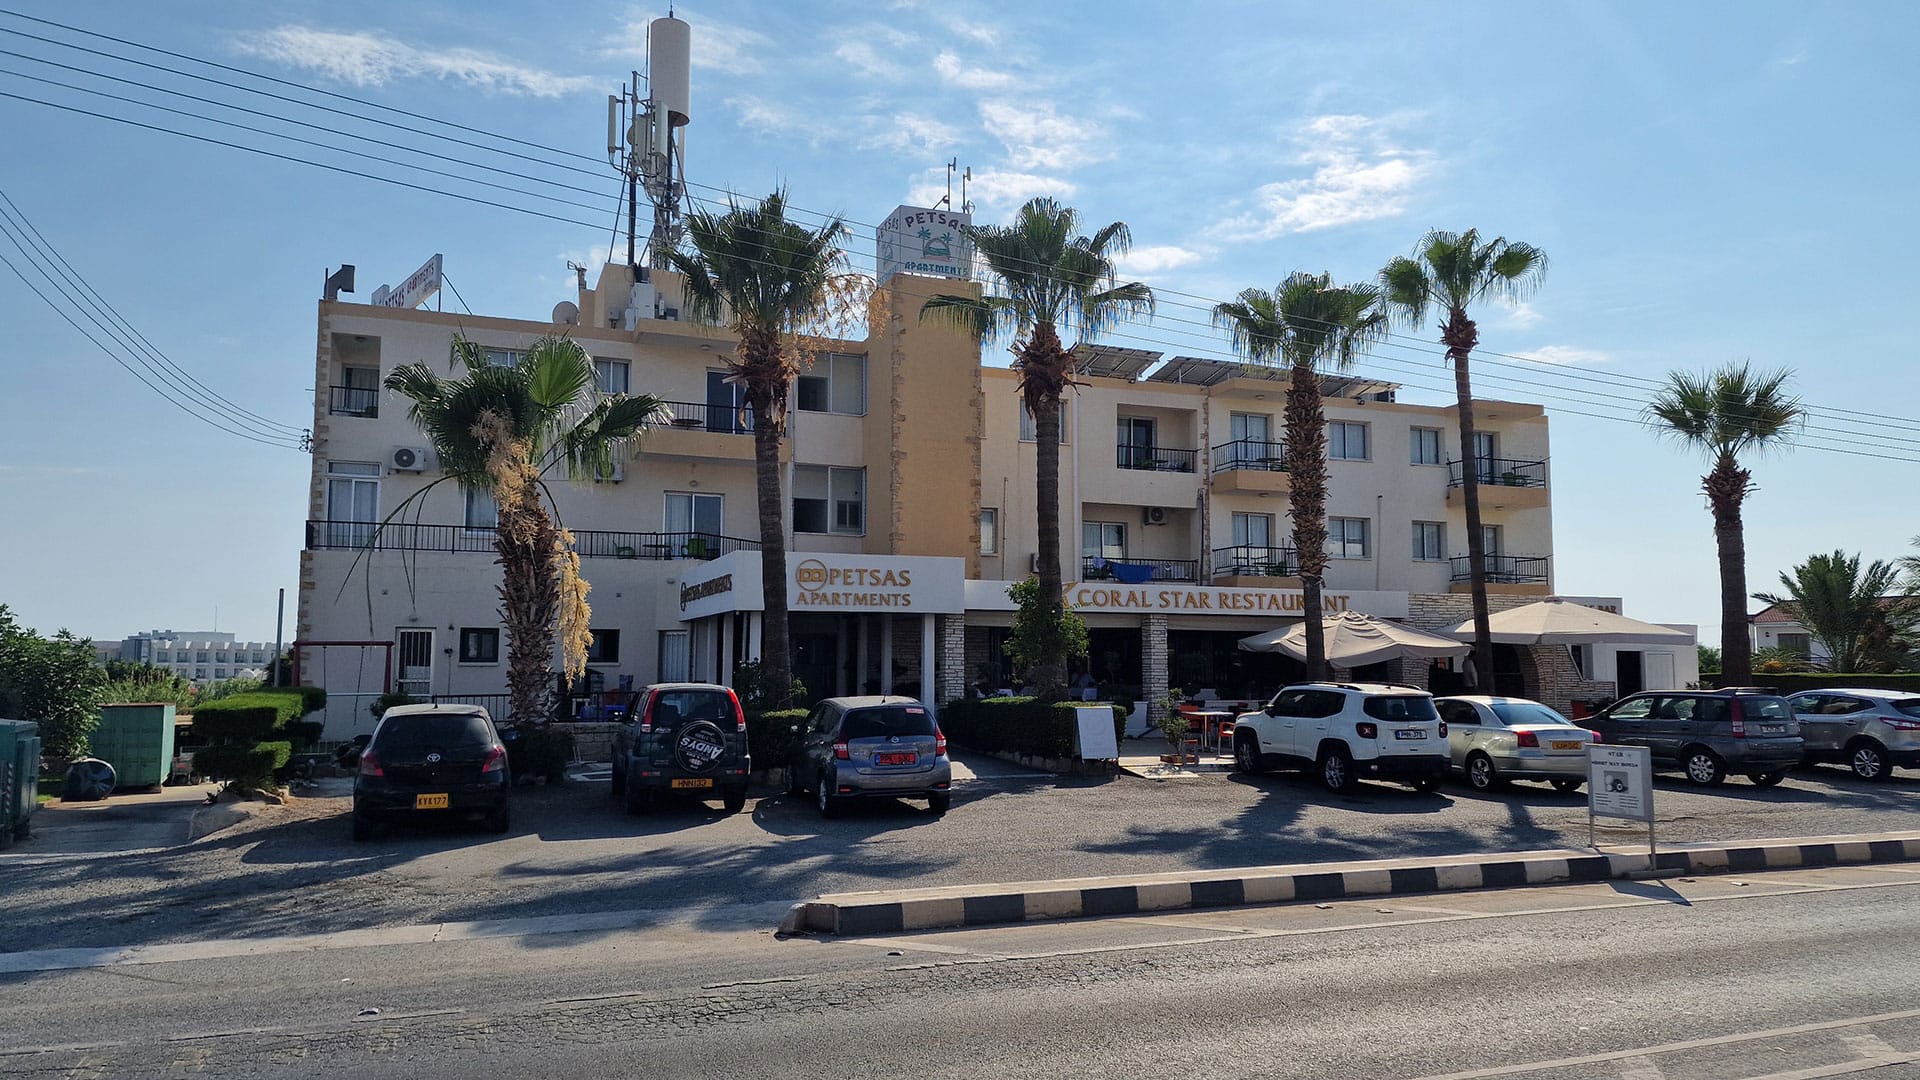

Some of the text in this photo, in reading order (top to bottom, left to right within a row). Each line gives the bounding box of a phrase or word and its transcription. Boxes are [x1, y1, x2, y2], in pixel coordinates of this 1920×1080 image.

[904, 212, 966, 232] PETSAS
[829, 569, 911, 588] PETSAS
[796, 591, 911, 607] APARTMENTS
[1078, 588, 1350, 612] CORAL STAR RESTAURNT
[680, 737, 724, 759] ANDYS
